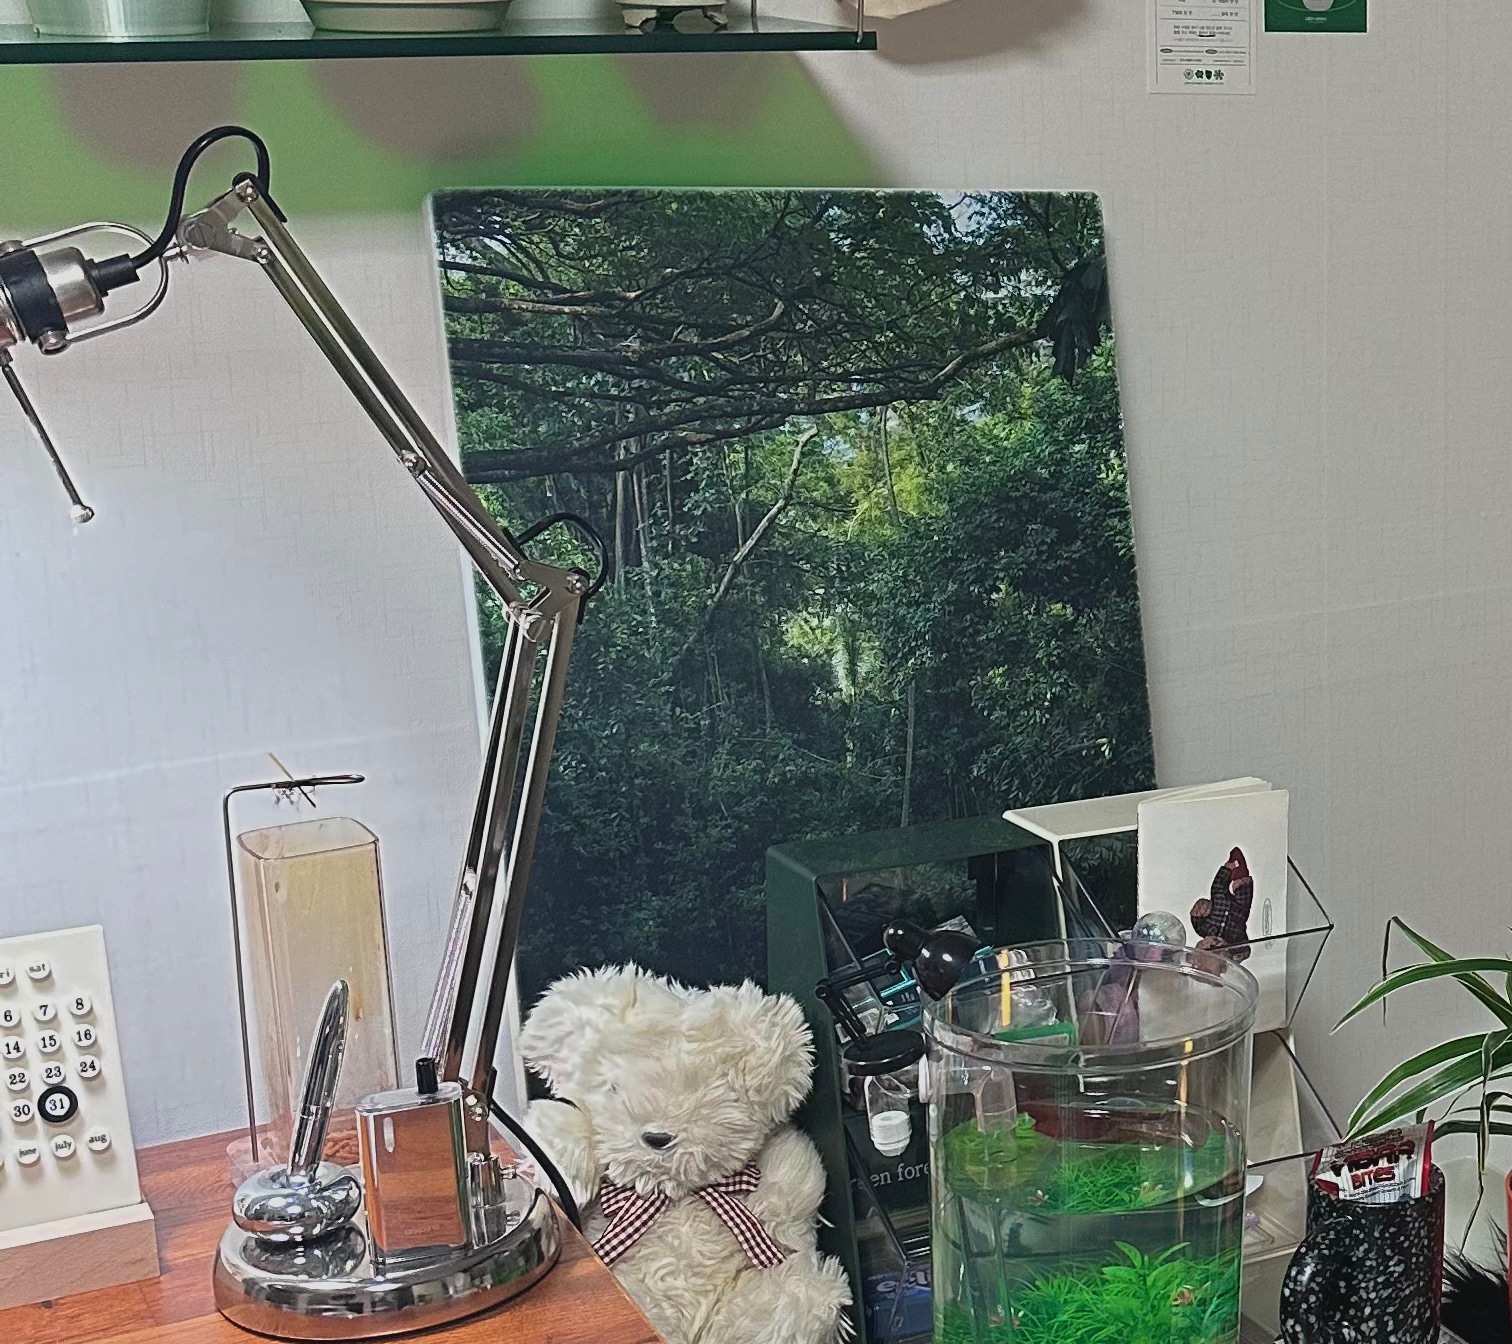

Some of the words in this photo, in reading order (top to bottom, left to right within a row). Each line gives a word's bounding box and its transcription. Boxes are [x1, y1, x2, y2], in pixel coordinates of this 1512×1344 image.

[29, 962, 46, 973] sat
[4, 1009, 13, 1023] 6
[39, 1004, 49, 1017] 7
[75, 997, 84, 1011] 8
[5, 1040, 21, 1055] 14
[40, 1034, 57, 1049] 15
[75, 1028, 92, 1043] 16
[8, 1072, 26, 1086] 22
[45, 1065, 62, 1080] 23
[79, 1059, 97, 1074] 24
[13, 1103, 30, 1118] 30
[49, 1097, 65, 1111] 31
[19, 1147, 37, 1157] june
[54, 1140, 72, 1152] july
[88, 1132, 107, 1144] aug
[1352, 1166, 1395, 1190] BITES
